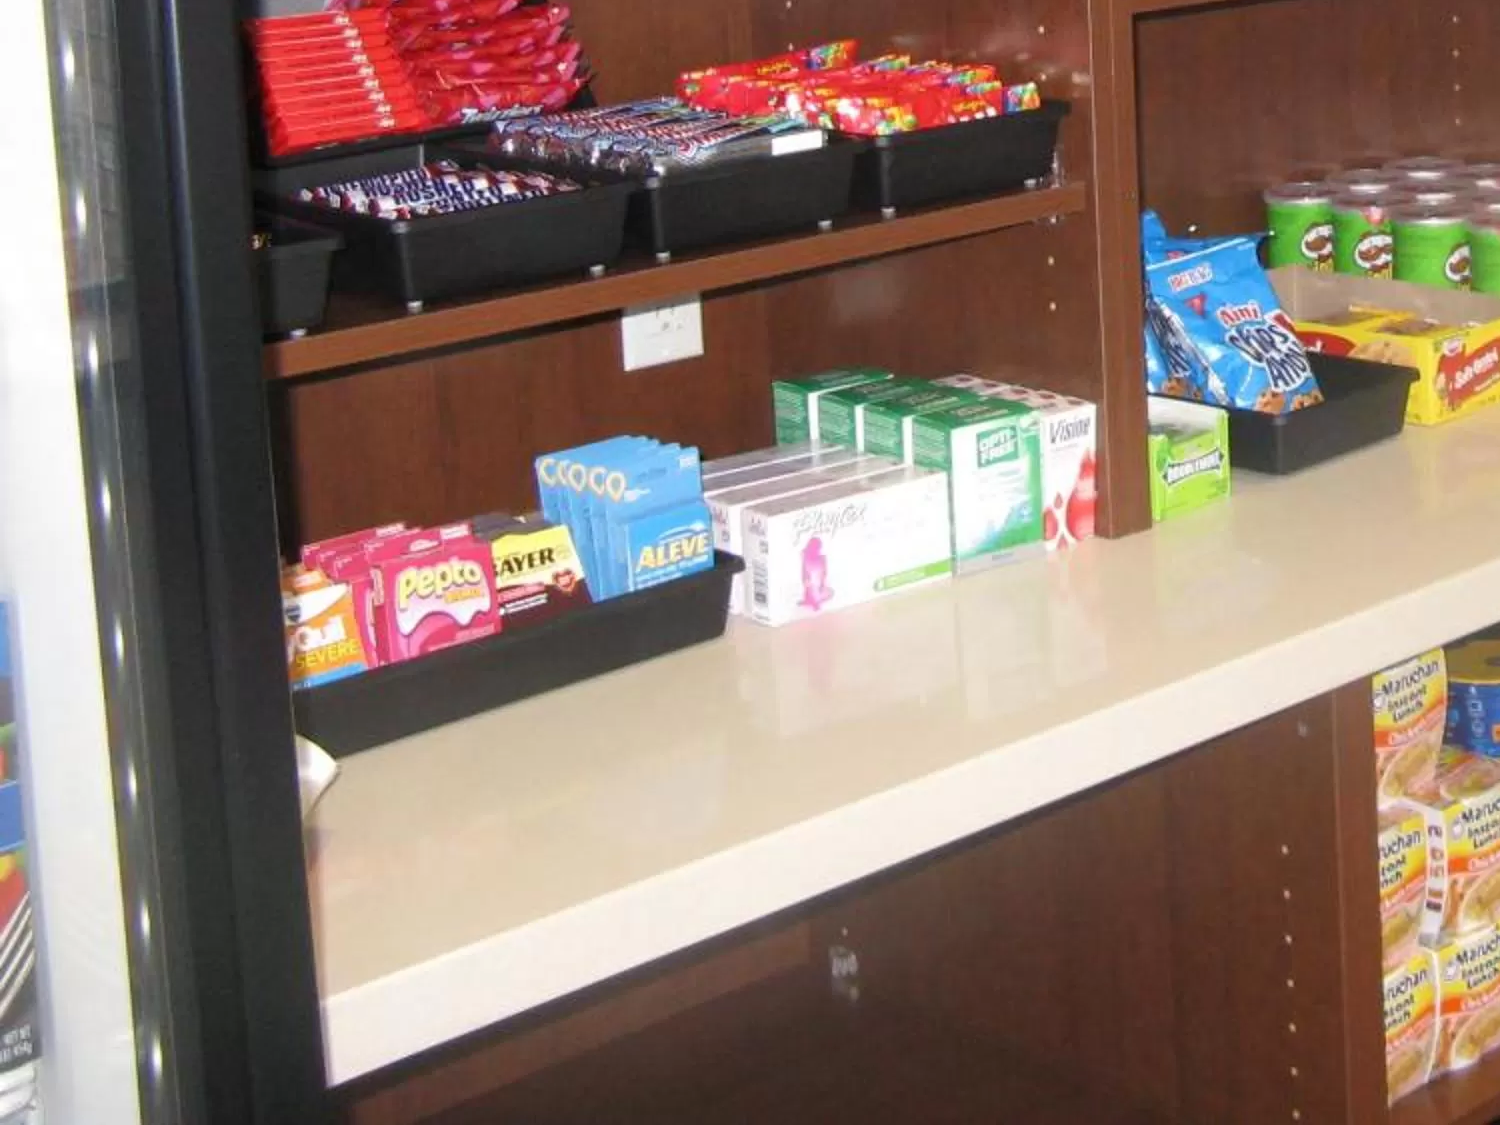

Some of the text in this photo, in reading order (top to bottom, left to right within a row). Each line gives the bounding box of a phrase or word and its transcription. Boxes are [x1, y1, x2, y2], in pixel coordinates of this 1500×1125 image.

[1049, 415, 1092, 444] Visine
[495, 546, 555, 578] AYER
[637, 534, 709, 573] ALEVE
[400, 558, 482, 610] Pepto
[295, 640, 359, 668] SEVERE
[1381, 659, 1440, 695] Maruchan
[1466, 966, 1500, 990] Lunch
